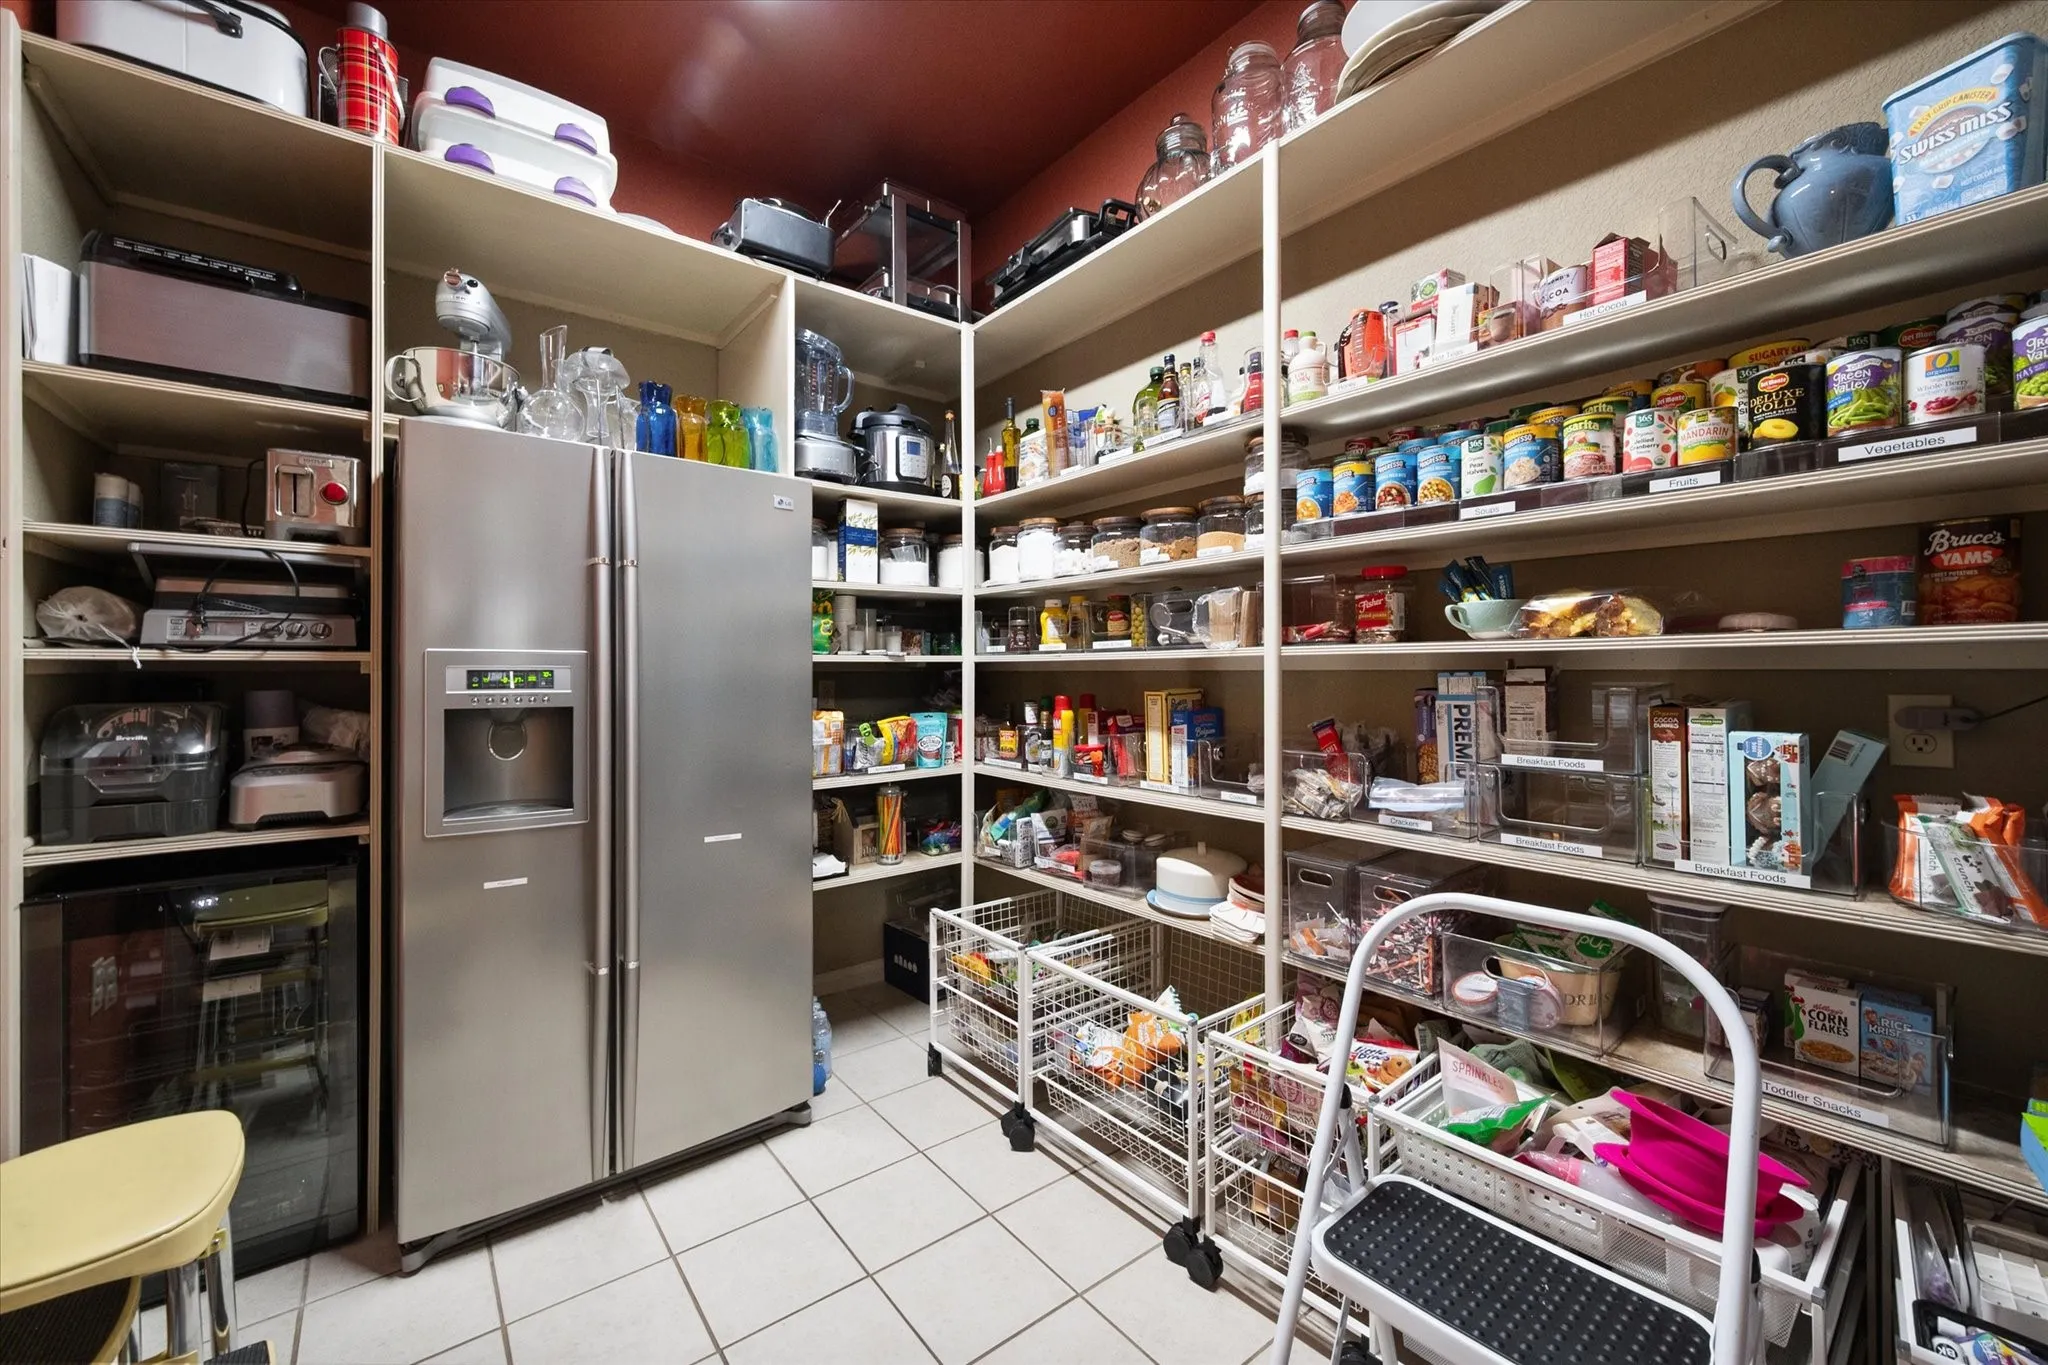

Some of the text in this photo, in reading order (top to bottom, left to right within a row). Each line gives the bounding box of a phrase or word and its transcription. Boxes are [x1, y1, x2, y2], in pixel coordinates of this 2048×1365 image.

[1579, 300, 1628, 320] Hot Cocoa
[1850, 336, 1869, 346] 365
[1915, 330, 1938, 341] Mont
[1748, 347, 1791, 363] SUGARY
[1739, 367, 1758, 379] 365
[1926, 366, 1960, 377] organics
[1750, 388, 1805, 408] DELUXE
[1754, 398, 1796, 415] GOLD
[1638, 413, 1653, 422] 365
[1680, 426, 1730, 443] MANDARIN
[1469, 440, 1483, 448] 365
[1864, 434, 1946, 456] Vegetables
[1469, 462, 1484, 470] Pear
[1669, 477, 1699, 489] Fruits
[1474, 507, 1500, 516] Soups
[1924, 529, 2002, 556] Bruce's
[1940, 550, 1994, 566] YAMS
[1358, 597, 1384, 613] Fisher
[1453, 704, 1475, 779] PREMIU
[1516, 756, 1586, 769] Breakfast Foods
[1390, 818, 1419, 828] Crackers
[1516, 836, 1585, 854] Breakfast Foods
[1694, 863, 1787, 885] Breakfast Foods
[1953, 857, 1976, 892] crunch
[1808, 1009, 1849, 1028] CORN
[1881, 1018, 1912, 1032] RICE
[1808, 1020, 1849, 1037] FLAKES
[1451, 1060, 1504, 1091] SPRINKLES
[1763, 1082, 1862, 1119] Toddler Snacks
